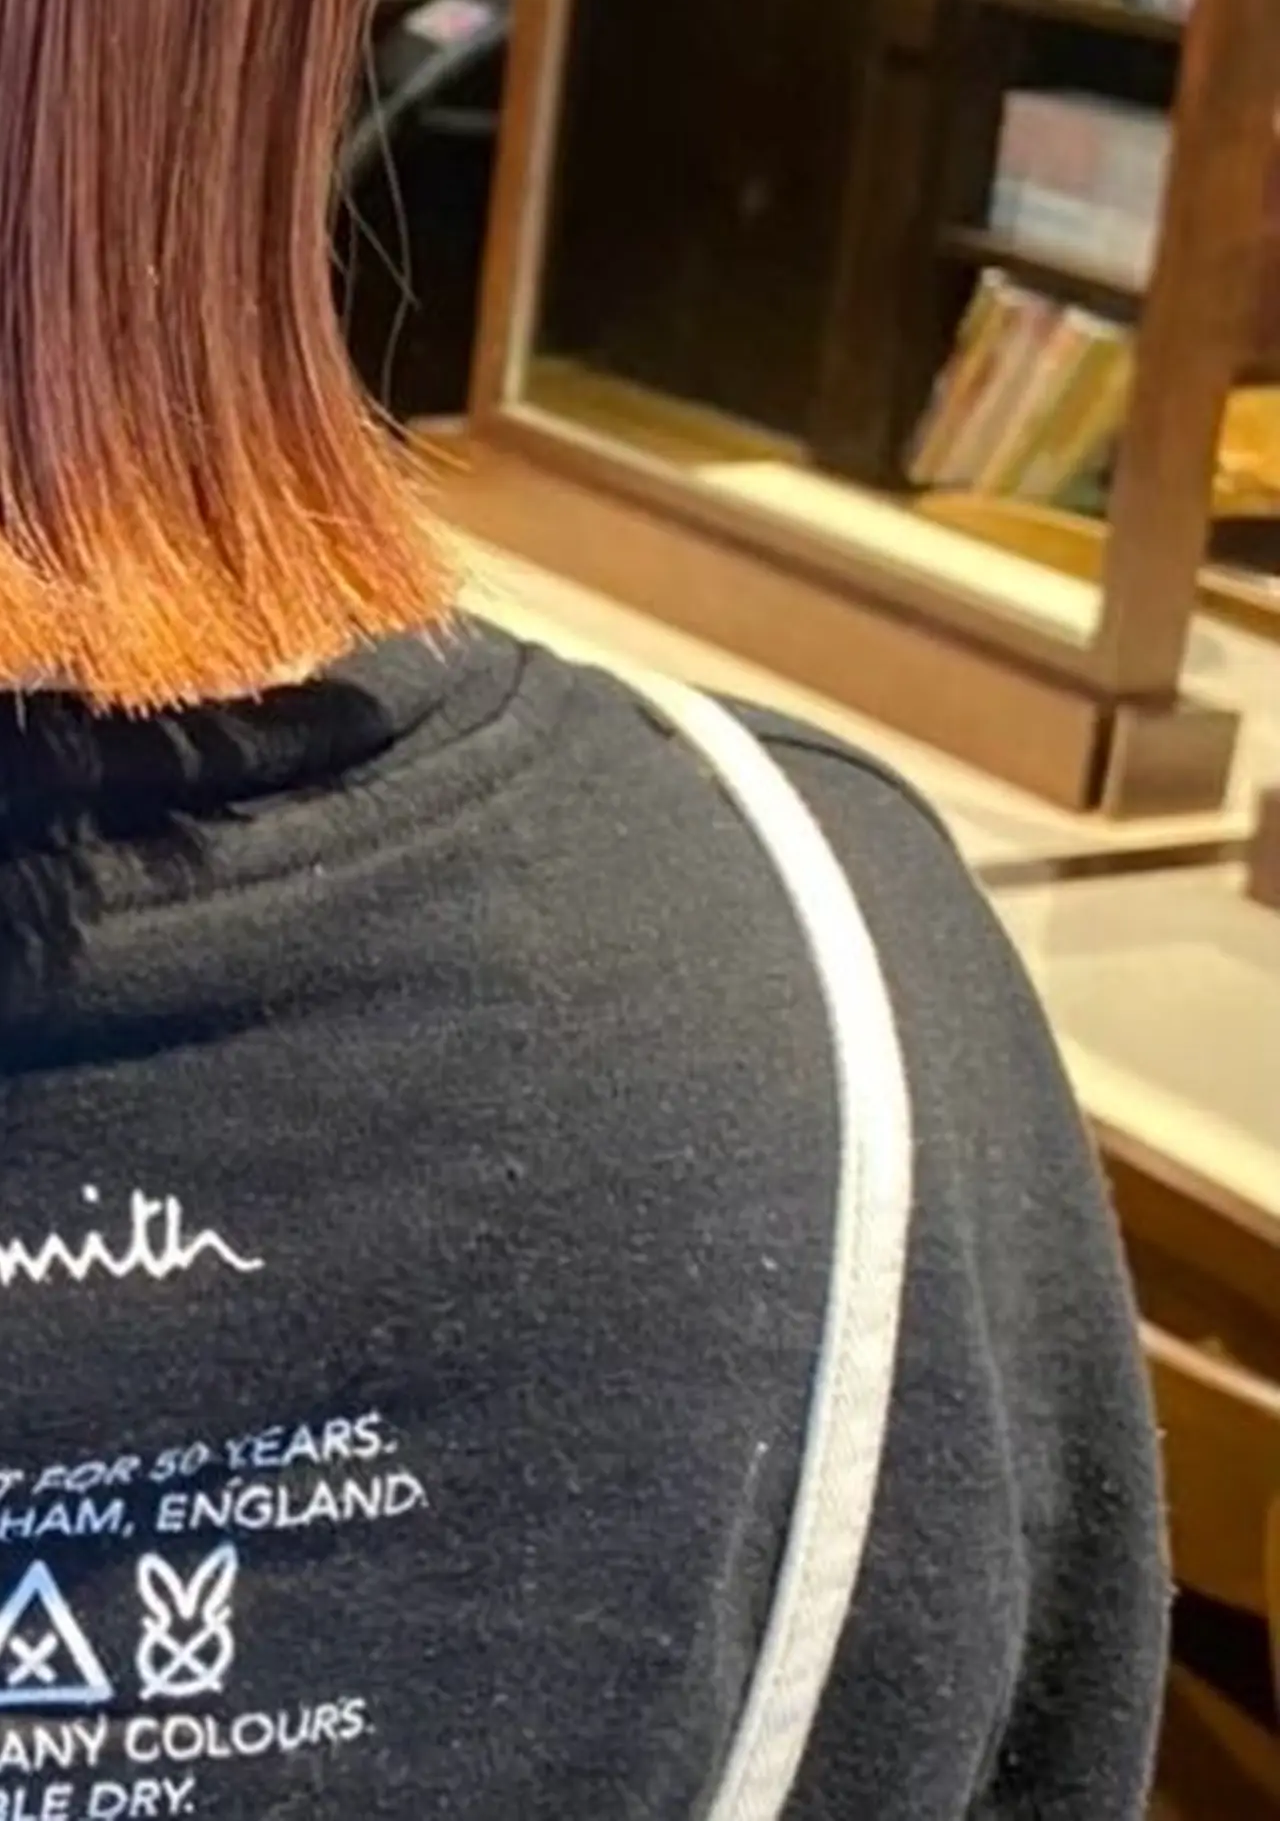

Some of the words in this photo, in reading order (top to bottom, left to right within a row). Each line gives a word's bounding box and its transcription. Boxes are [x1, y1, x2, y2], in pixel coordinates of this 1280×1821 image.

[33, 1457, 140, 1495] FOR
[150, 1443, 210, 1480] 50
[225, 1412, 398, 1470] YEARS.
[88, 1776, 196, 1819] DRY.
